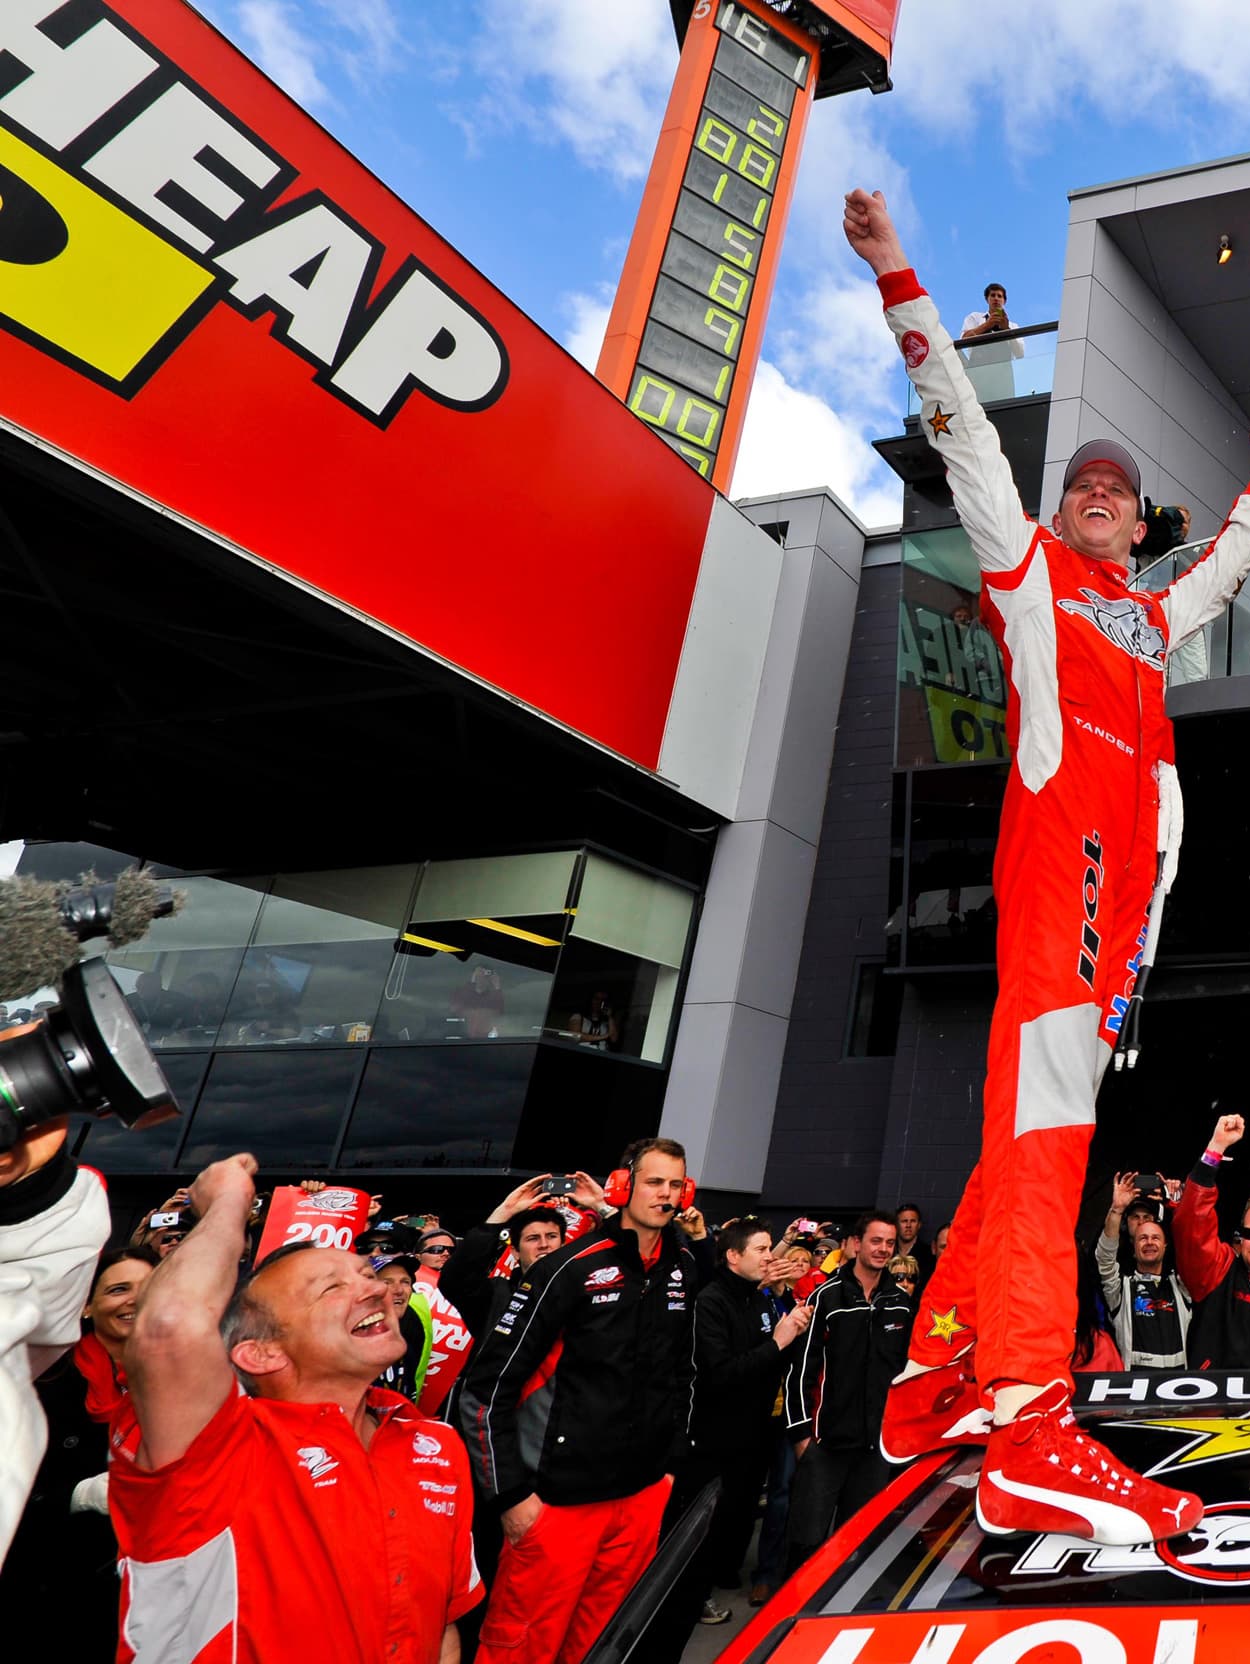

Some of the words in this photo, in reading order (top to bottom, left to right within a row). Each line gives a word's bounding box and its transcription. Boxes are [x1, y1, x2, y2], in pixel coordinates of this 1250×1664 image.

[747, 105, 784, 149] 2
[697, 117, 776, 188] 88
[722, 223, 756, 269] 5
[708, 264, 749, 310] 8
[1073, 716, 1135, 757] TANDER
[283, 1222, 353, 1250] 200
